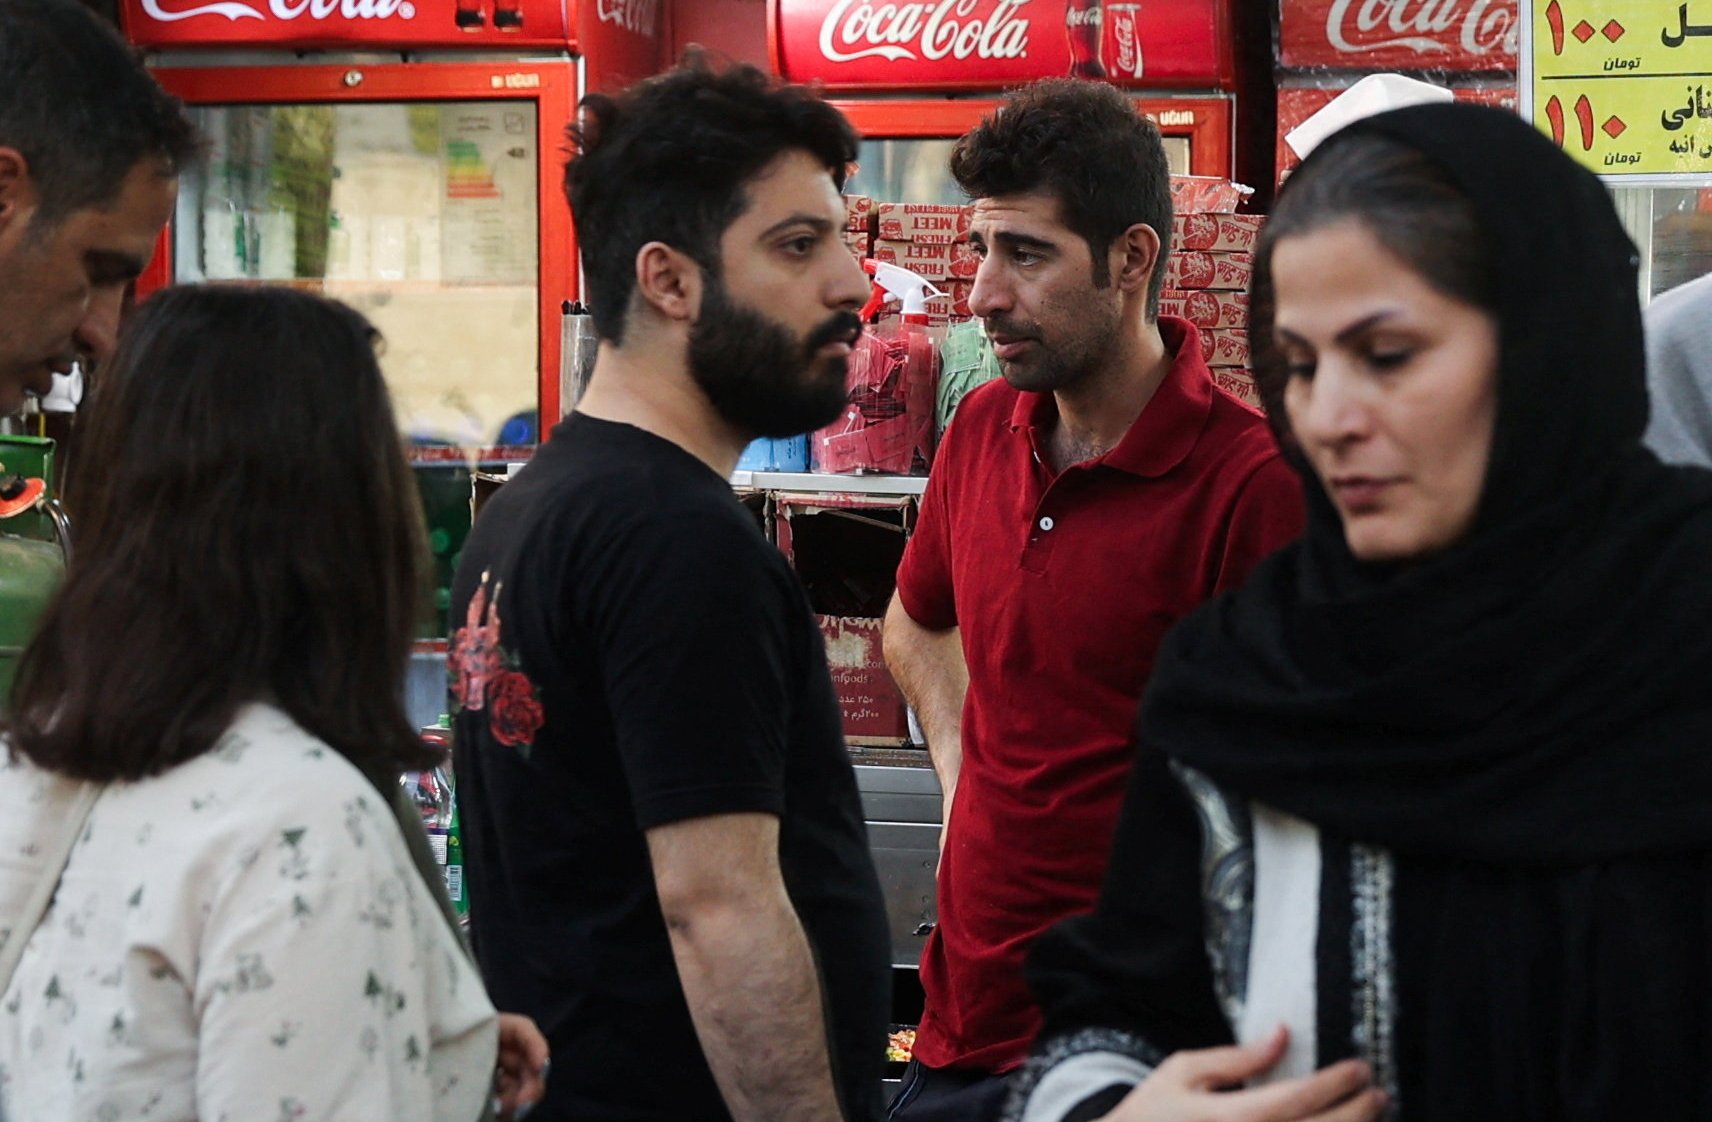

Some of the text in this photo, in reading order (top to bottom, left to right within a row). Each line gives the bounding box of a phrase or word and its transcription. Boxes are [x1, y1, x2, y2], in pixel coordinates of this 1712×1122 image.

[1545, 0, 1626, 56] ۱۰۰
[1603, 56, 1640, 71] تومان
[1545, 94, 1627, 152] ۱۱۰
[1603, 151, 1641, 166] تومان
[912, 217, 952, 229] MEET
[904, 245, 945, 258] MEET
